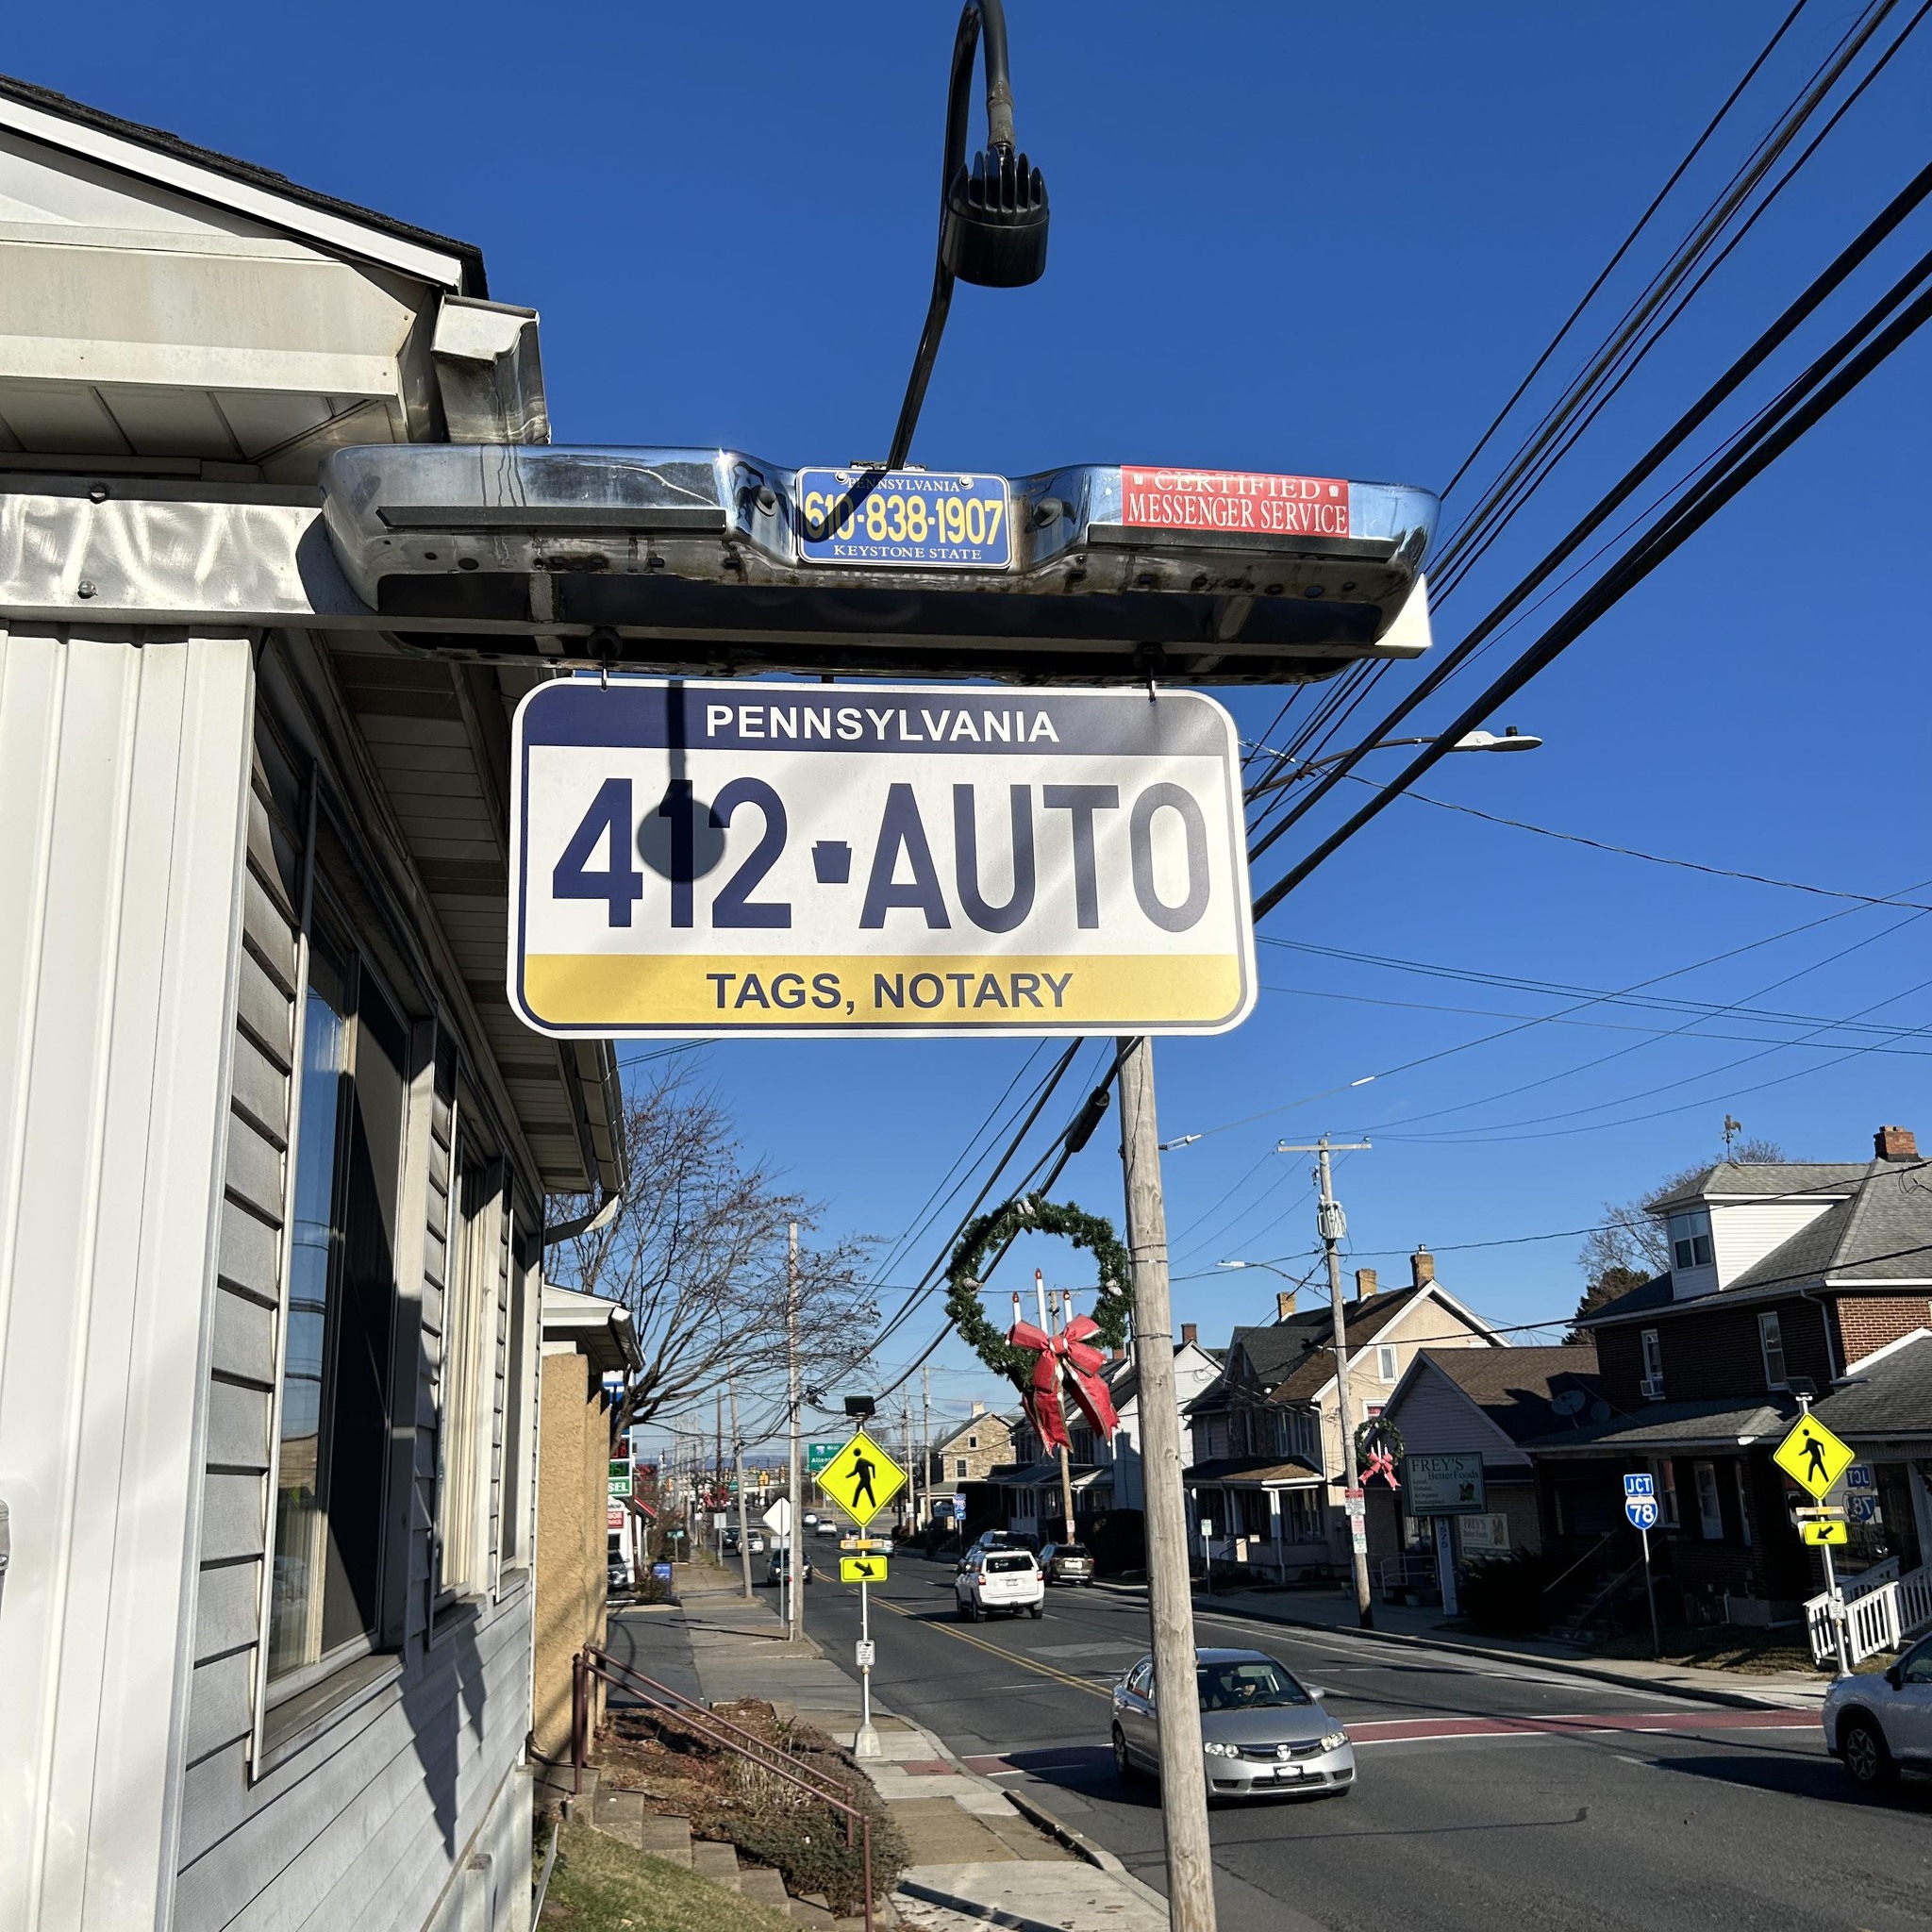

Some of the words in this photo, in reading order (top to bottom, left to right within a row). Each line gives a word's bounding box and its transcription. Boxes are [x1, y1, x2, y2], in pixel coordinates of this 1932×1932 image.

[847, 477, 960, 492] PENNSYLVANIA
[1154, 471, 1321, 499] CERTIFIED
[805, 491, 1004, 545] 610-838-1907
[1127, 493, 1255, 528] MESSENGER
[1260, 500, 1347, 534] SERVICE
[833, 544, 924, 558] KEYSTONE
[929, 547, 982, 559] STATE
[706, 704, 1058, 743] PENNSYLVANIA
[707, 973, 855, 1016] TAGS,
[874, 973, 1074, 1009] NOTARY
[1411, 1458, 1464, 1472] FREY'S
[1627, 1477, 1652, 1493] JCT
[1630, 1504, 1654, 1523] 78
